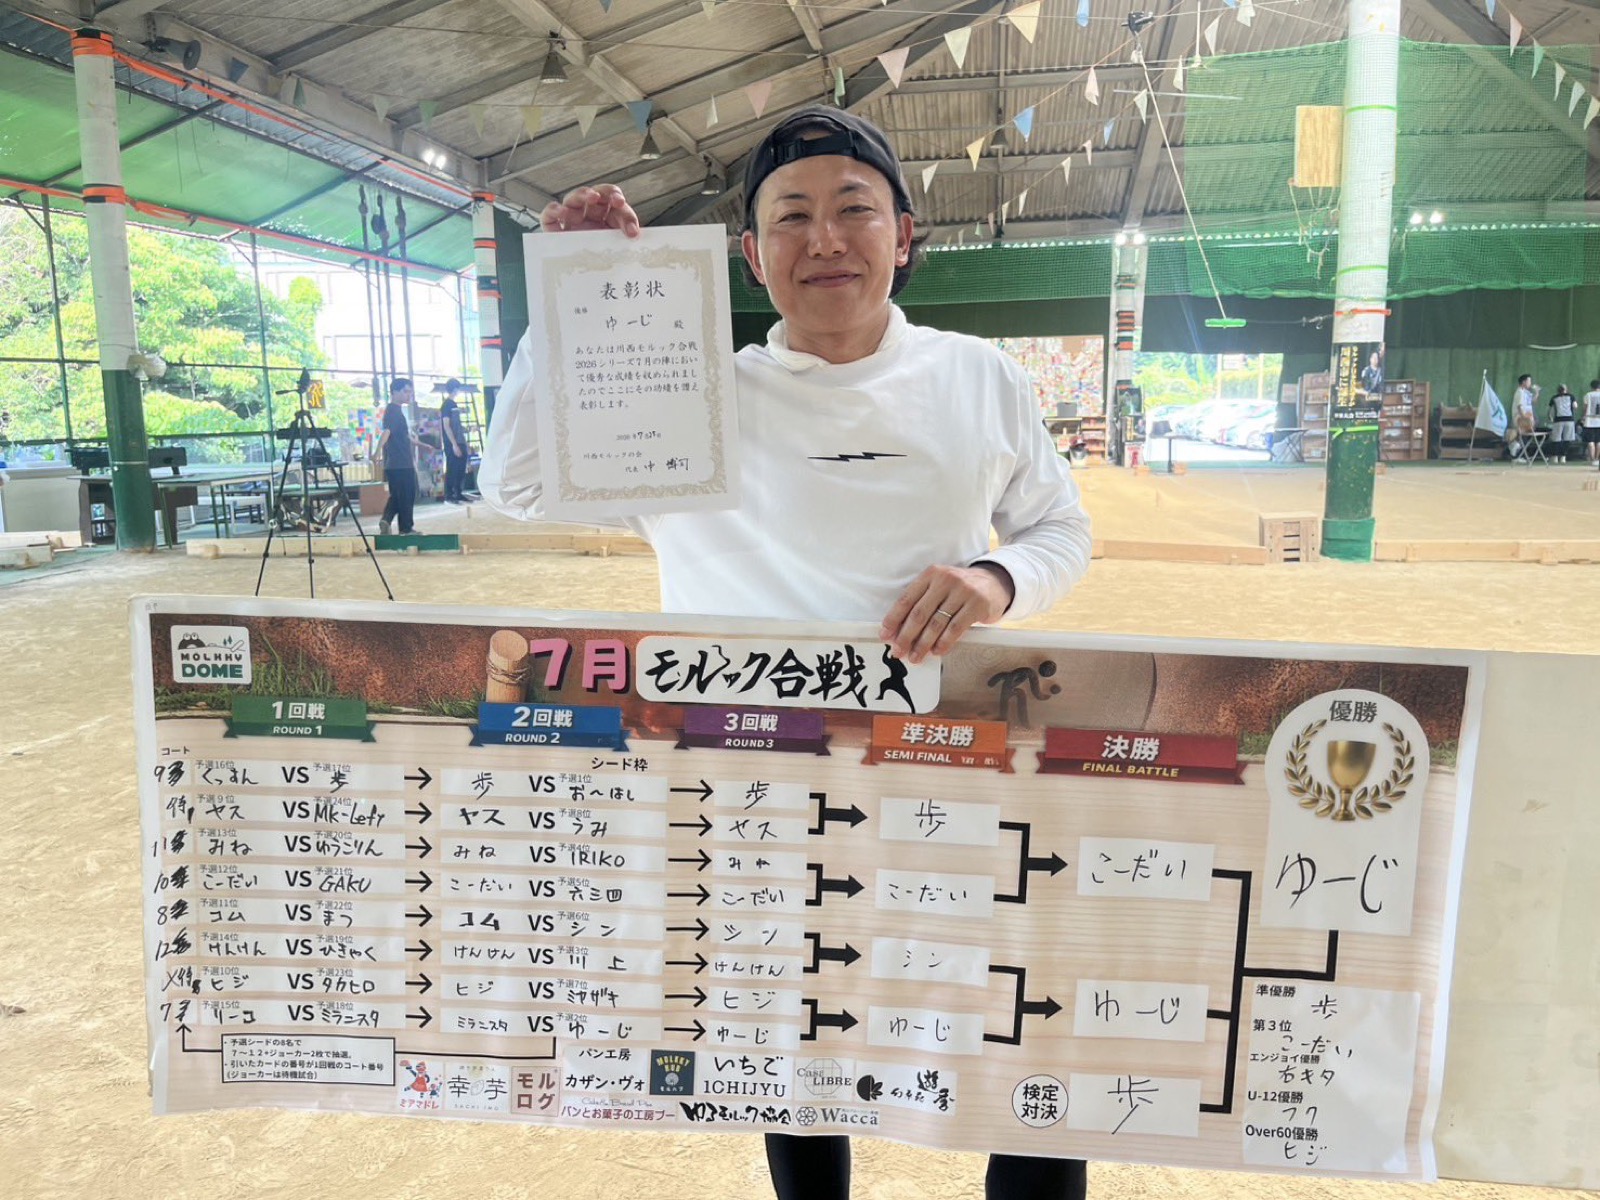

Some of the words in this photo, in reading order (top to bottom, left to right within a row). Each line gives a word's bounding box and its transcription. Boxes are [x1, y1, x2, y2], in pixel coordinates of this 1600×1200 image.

[601, 280, 665, 300] 表彰状
[606, 314, 652, 331] ゆーじ
[575, 341, 698, 354] あなたは川西モルック合戦
[581, 399, 629, 410] 表彰します。
[181, 664, 243, 679] DOME
[529, 638, 631, 694] 7月
[645, 644, 868, 708] モルック合戦
[272, 701, 325, 720] 1回戦
[511, 707, 574, 729] 2回戦
[1329, 700, 1378, 723] 優勝
[273, 726, 312, 735] ROUND
[315, 725, 323, 735] 1
[724, 713, 778, 732] 3回戦
[505, 733, 547, 744] ROUND
[550, 732, 561, 744] 2
[901, 722, 975, 747] 準決勝
[161, 747, 190, 755] コート
[1101, 735, 1161, 761] 決勝
[591, 757, 649, 771] シード枠
[884, 750, 914, 762] SEMI
[917, 752, 952, 765] FINAL
[281, 766, 309, 784] VS
[1082, 763, 1123, 775] FINAL
[1126, 765, 1179, 778] BATTLE
[471, 771, 495, 800] 歩
[529, 775, 556, 793] VS
[744, 780, 770, 810] 歩
[205, 804, 245, 821] ヤス
[282, 801, 310, 819] VS
[459, 807, 505, 826] ヤス
[915, 799, 947, 837] 歩
[529, 811, 556, 829] VS
[572, 819, 608, 838] うみ
[729, 820, 778, 840] ヤス
[208, 838, 253, 856] みね
[284, 835, 311, 852] VS
[529, 846, 556, 863] VS
[571, 851, 626, 868] IRIKO
[285, 870, 312, 887] VS
[1275, 853, 1399, 914] ゆーじ
[529, 880, 556, 898] VS
[157, 905, 168, 925] 8
[210, 911, 246, 923] コム
[285, 904, 312, 922] VS
[323, 910, 353, 928] まつ
[459, 912, 500, 931] コム
[528, 914, 554, 932] VS
[571, 921, 617, 937] シン
[724, 924, 778, 945] シン
[285, 938, 313, 955] VS
[454, 946, 515, 960] けんけん
[528, 948, 554, 965] VS
[570, 955, 627, 971] 川上
[714, 961, 785, 977] けんけん
[211, 974, 249, 991] ヒジ
[287, 973, 314, 990] VS
[322, 977, 375, 994] タカヒロ
[456, 980, 494, 996] ヒジ
[529, 982, 555, 999] VS
[1256, 984, 1296, 998] 準優勝
[723, 990, 776, 1009] ヒジ
[1094, 990, 1180, 1024] ゆーじ
[160, 1002, 171, 1022] 7
[213, 1009, 257, 1025] リーコ
[287, 1004, 315, 1021] VS
[527, 1016, 554, 1032] VS
[568, 1021, 632, 1039] ゆーじ
[889, 1017, 951, 1042] ゆーじ
[1253, 1018, 1292, 1032] 第3位
[717, 1027, 769, 1045] ゆーじ
[579, 1048, 632, 1061] パン工房
[1250, 1053, 1320, 1064] エンジョイ優勝
[714, 1055, 784, 1076] いちご
[517, 1073, 556, 1089] モル
[565, 1074, 645, 1091] カザン・ヴォ
[813, 1077, 852, 1086] LIBRE
[1022, 1084, 1059, 1101] 検定
[1247, 1090, 1303, 1104] U-12優勝
[400, 1099, 439, 1110] ミアマドレ
[517, 1093, 556, 1110] ログ
[1107, 1075, 1159, 1135] 歩
[679, 1101, 792, 1125] ゆるモルック協会
[821, 1108, 878, 1125] Wacca
[1021, 1102, 1058, 1120] 対決
[1245, 1125, 1319, 1141] Over60優勝
[1284, 1141, 1328, 1166] ヒジ
